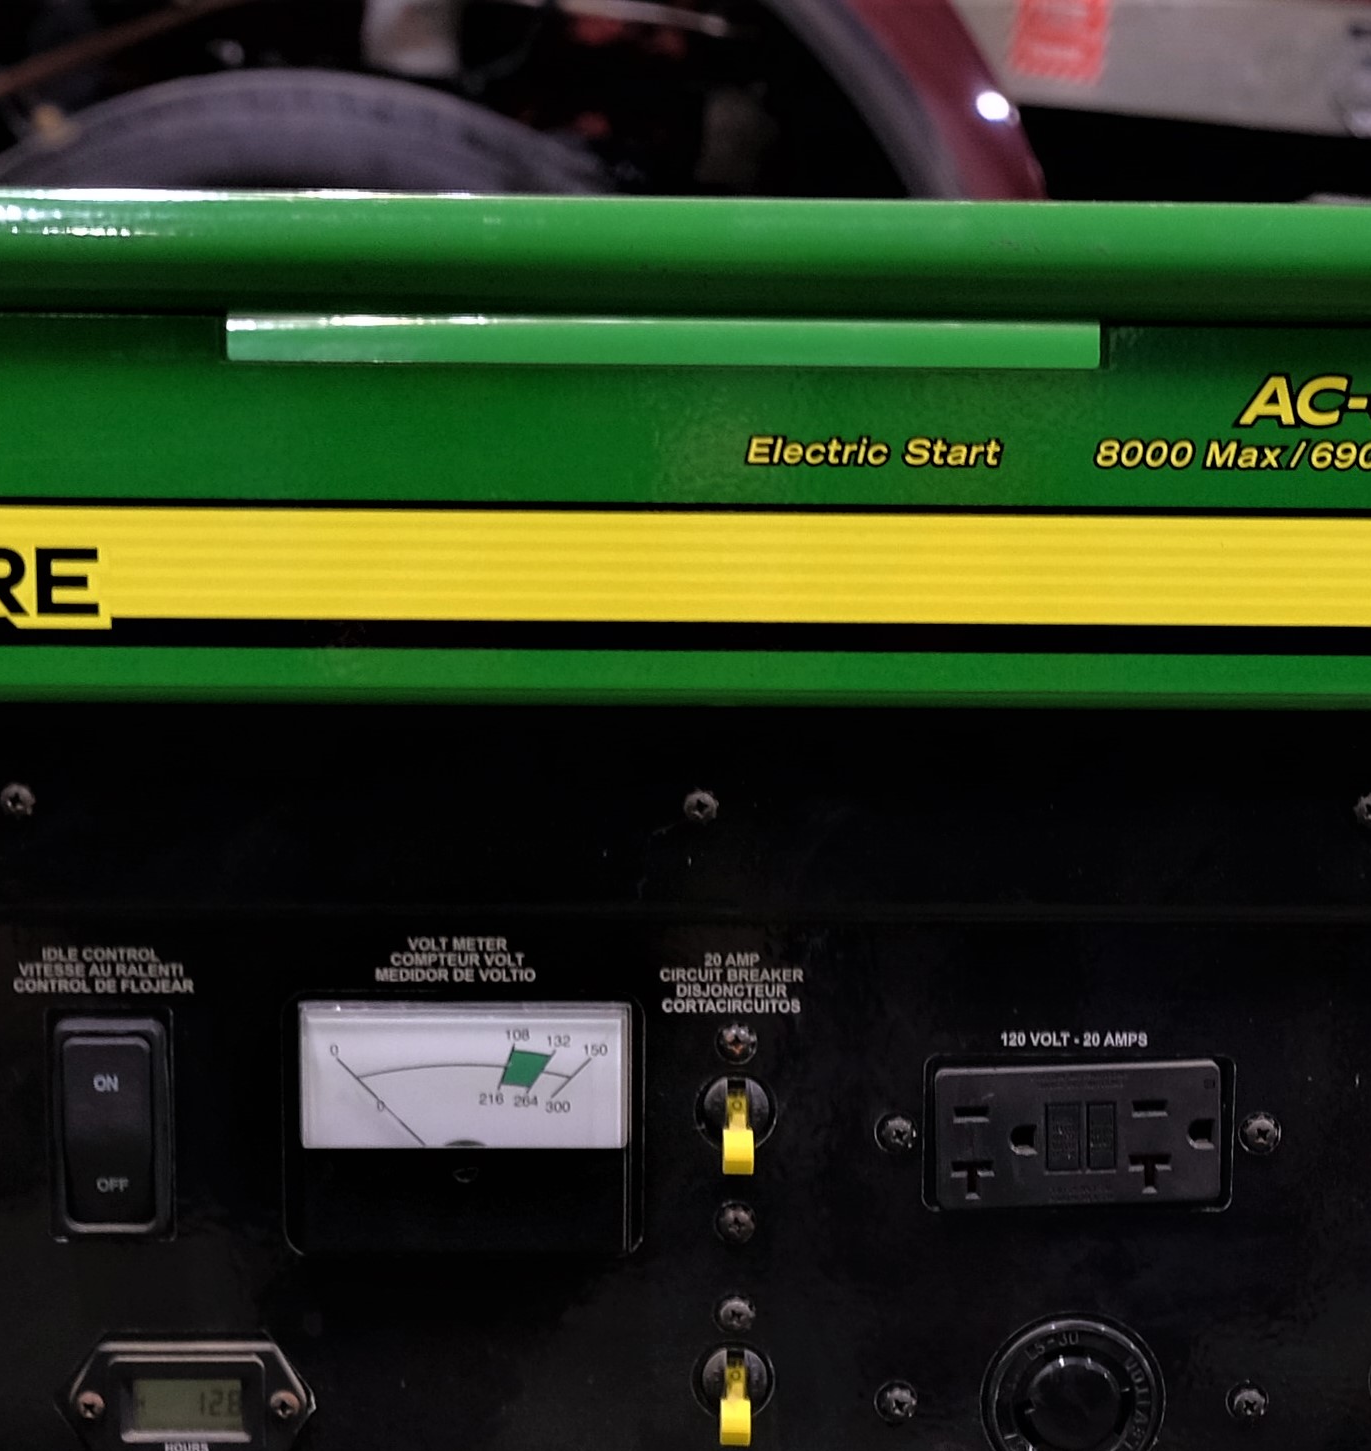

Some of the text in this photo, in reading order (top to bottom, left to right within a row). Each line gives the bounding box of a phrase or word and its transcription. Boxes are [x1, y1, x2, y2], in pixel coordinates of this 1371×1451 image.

[747, 437, 1001, 466] Electric Start
[1094, 439, 1193, 469] 8000
[407, 936, 508, 952] VOLT METER
[41, 947, 160, 963] IDLE CONTROL
[390, 952, 525, 968] COMPTEUR VOLT
[704, 952, 760, 968] 20 AMP
[18, 962, 184, 978] VITESSE AU RALENTI
[374, 967, 537, 983] MEDIDOR DE VOLTIO
[659, 968, 804, 983] CIRCUIT BREAKER
[13, 977, 194, 994] CONTROL DE FLOJEAR
[676, 983, 788, 998] DISJONCTEUR
[661, 998, 801, 1014] CORTACIRCUITOS
[505, 1028, 530, 1041] 108
[546, 1034, 571, 1048] 132
[1000, 1031, 1026, 1047] 120
[1029, 1031, 1071, 1047] VOLT
[1082, 1032, 1101, 1047] 20
[1103, 1031, 1148, 1047] AMPS
[330, 1044, 339, 1057] 0
[583, 1043, 608, 1056] 150
[93, 1074, 119, 1092] ON
[479, 1093, 504, 1106] 216
[545, 1101, 571, 1113] 300
[96, 1177, 129, 1193] OFF
